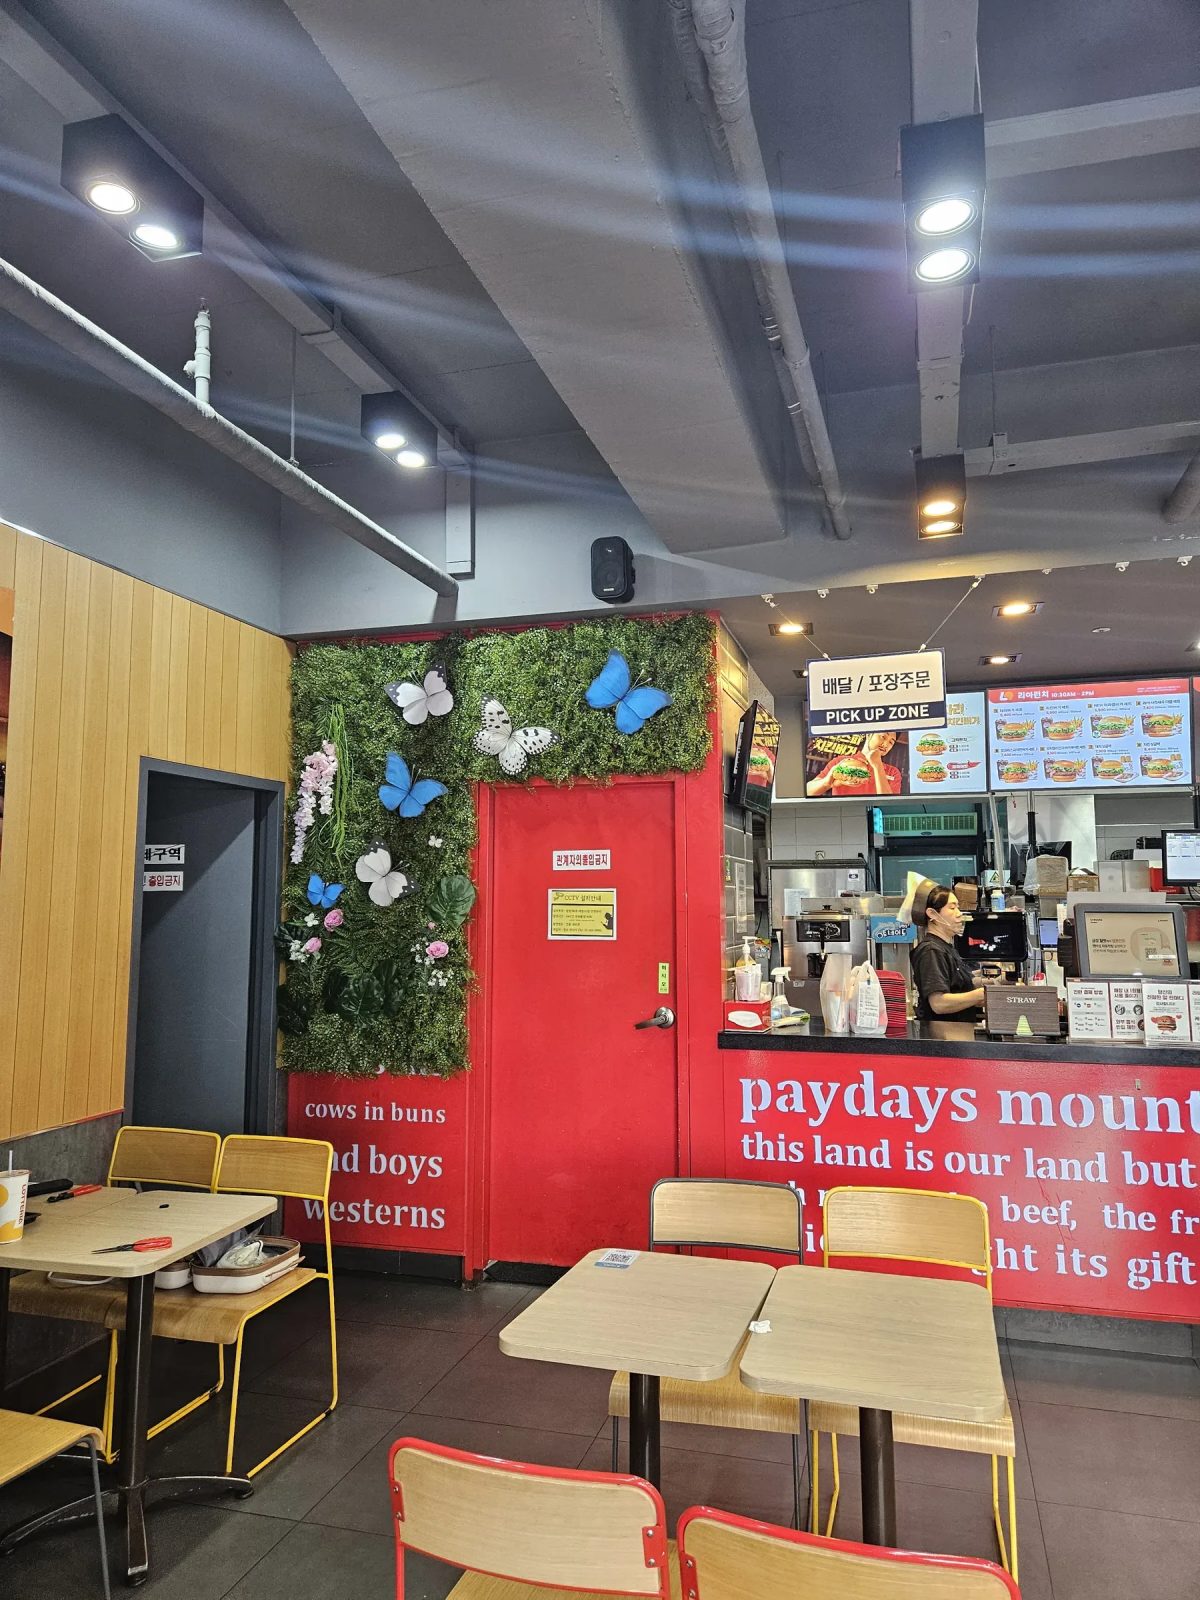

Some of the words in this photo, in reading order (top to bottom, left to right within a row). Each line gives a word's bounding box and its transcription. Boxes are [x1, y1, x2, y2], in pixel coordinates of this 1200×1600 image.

[822, 676, 853, 695] 배달
[868, 670, 931, 692] 포장주문
[1017, 690, 1050, 699] 리아런치
[826, 708, 862, 724] PICK
[864, 706, 885, 722] UP
[888, 704, 930, 720] ZONE
[813, 737, 858, 756] 치킨버거
[1006, 996, 1037, 1004] STRAW
[305, 1103, 357, 1120] cows
[364, 1101, 384, 1121] in
[391, 1102, 446, 1124] buns
[739, 1070, 978, 1133] paydays
[996, 1090, 1200, 1136] mount
[368, 1144, 443, 1185] boys
[741, 1131, 804, 1163] this
[813, 1135, 892, 1169] land
[905, 1141, 934, 1172] is
[944, 1150, 1011, 1177] our
[1023, 1147, 1109, 1184] land
[1121, 1150, 1198, 1189] but
[303, 1198, 446, 1230] westerns
[1000, 1195, 1077, 1231] beef,
[1101, 1202, 1157, 1232] the
[1055, 1244, 1108, 1278] its
[1127, 1251, 1197, 1291] gift
